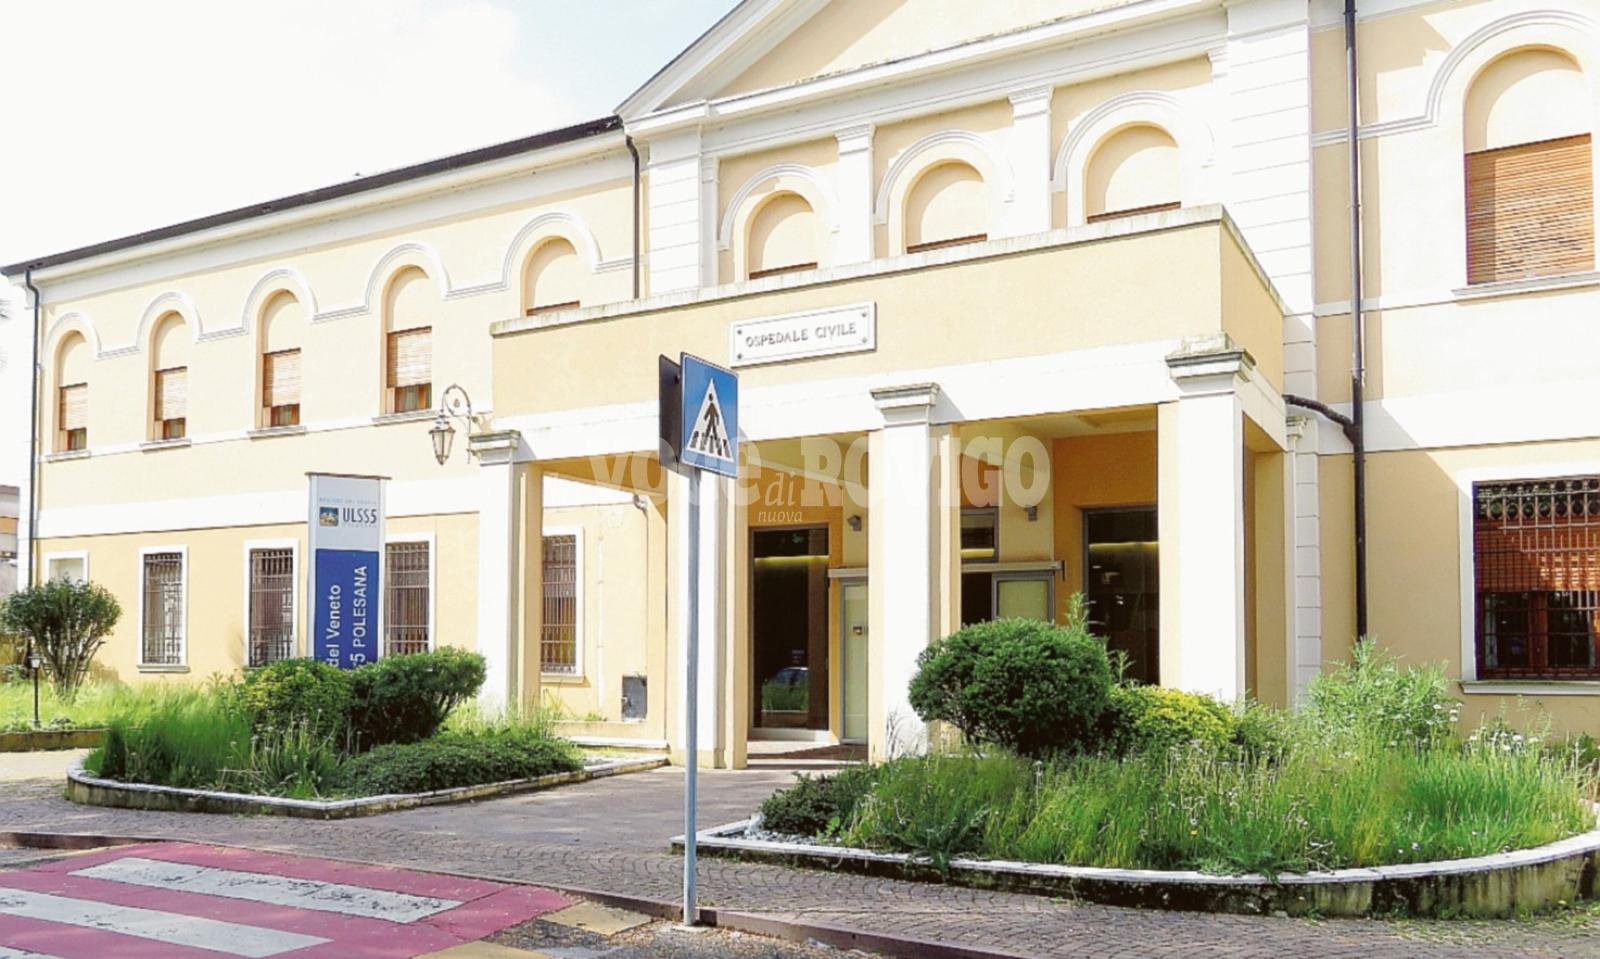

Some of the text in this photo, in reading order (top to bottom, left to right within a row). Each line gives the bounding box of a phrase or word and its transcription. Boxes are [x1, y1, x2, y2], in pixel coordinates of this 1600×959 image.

[745, 322, 857, 348] OSPEDALE CIVILE
[342, 507, 377, 524] ULSS5
[325, 584, 341, 668] del Veneto
[353, 565, 367, 648] POLESANA
